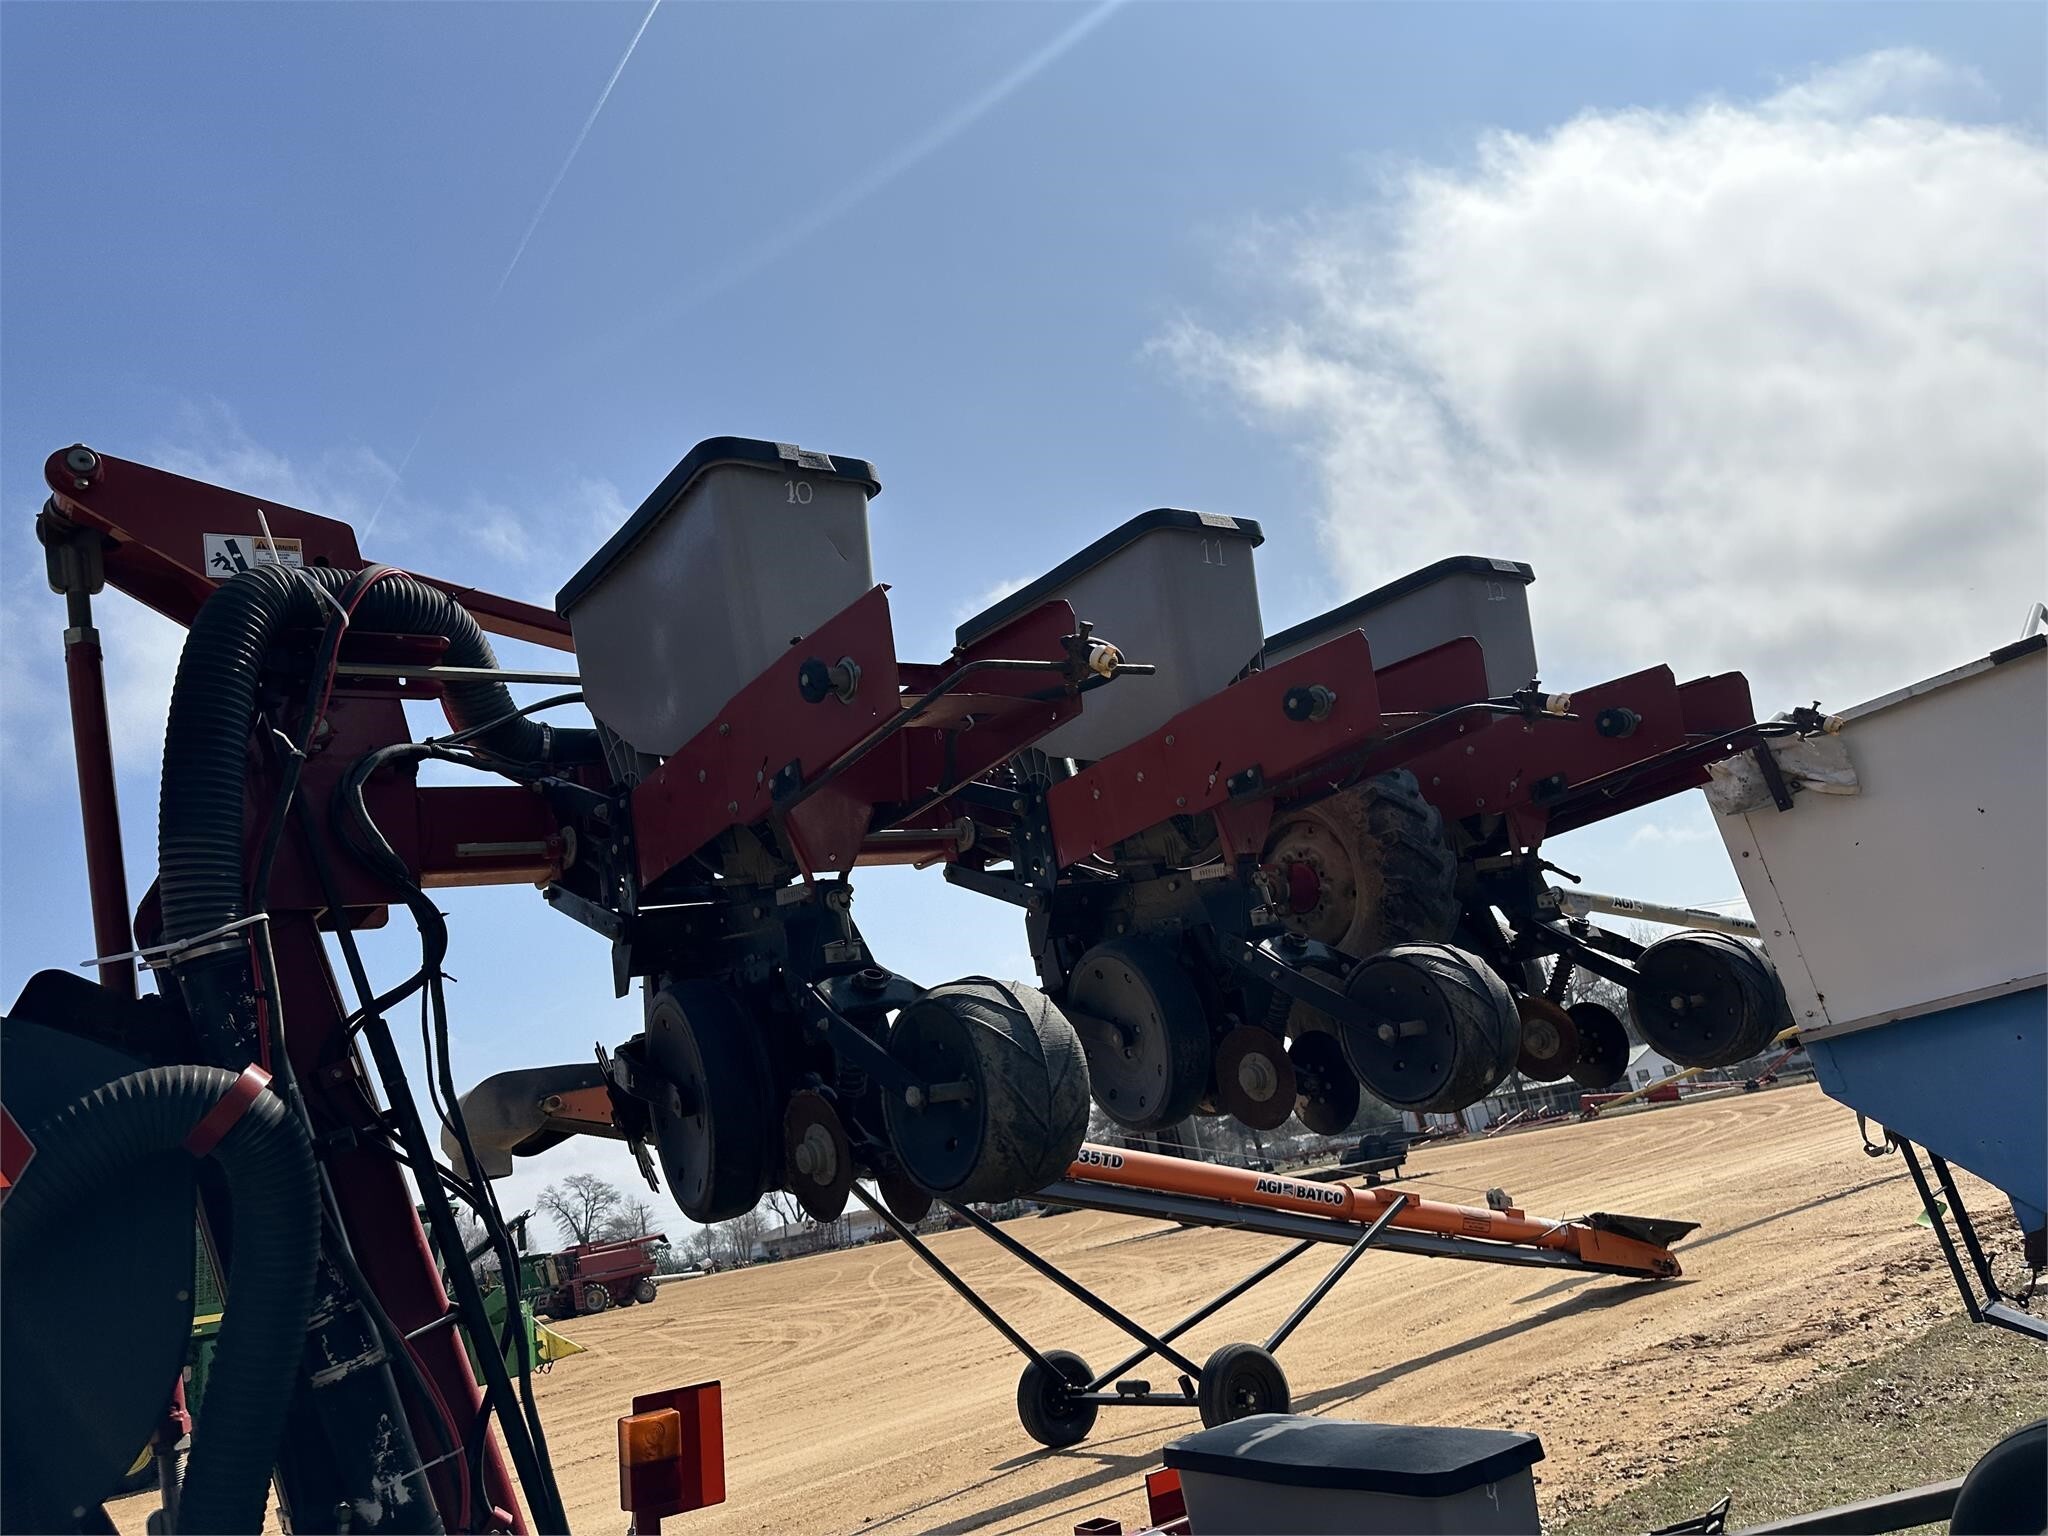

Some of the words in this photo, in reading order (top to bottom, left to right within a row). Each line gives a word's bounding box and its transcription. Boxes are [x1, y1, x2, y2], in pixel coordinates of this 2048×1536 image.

[784, 480, 813, 504] 10
[1200, 538, 1228, 567] 11
[1614, 897, 1634, 910] AGI
[1256, 1179, 1282, 1195] AGI
[1296, 1185, 1344, 1205] BATCO
